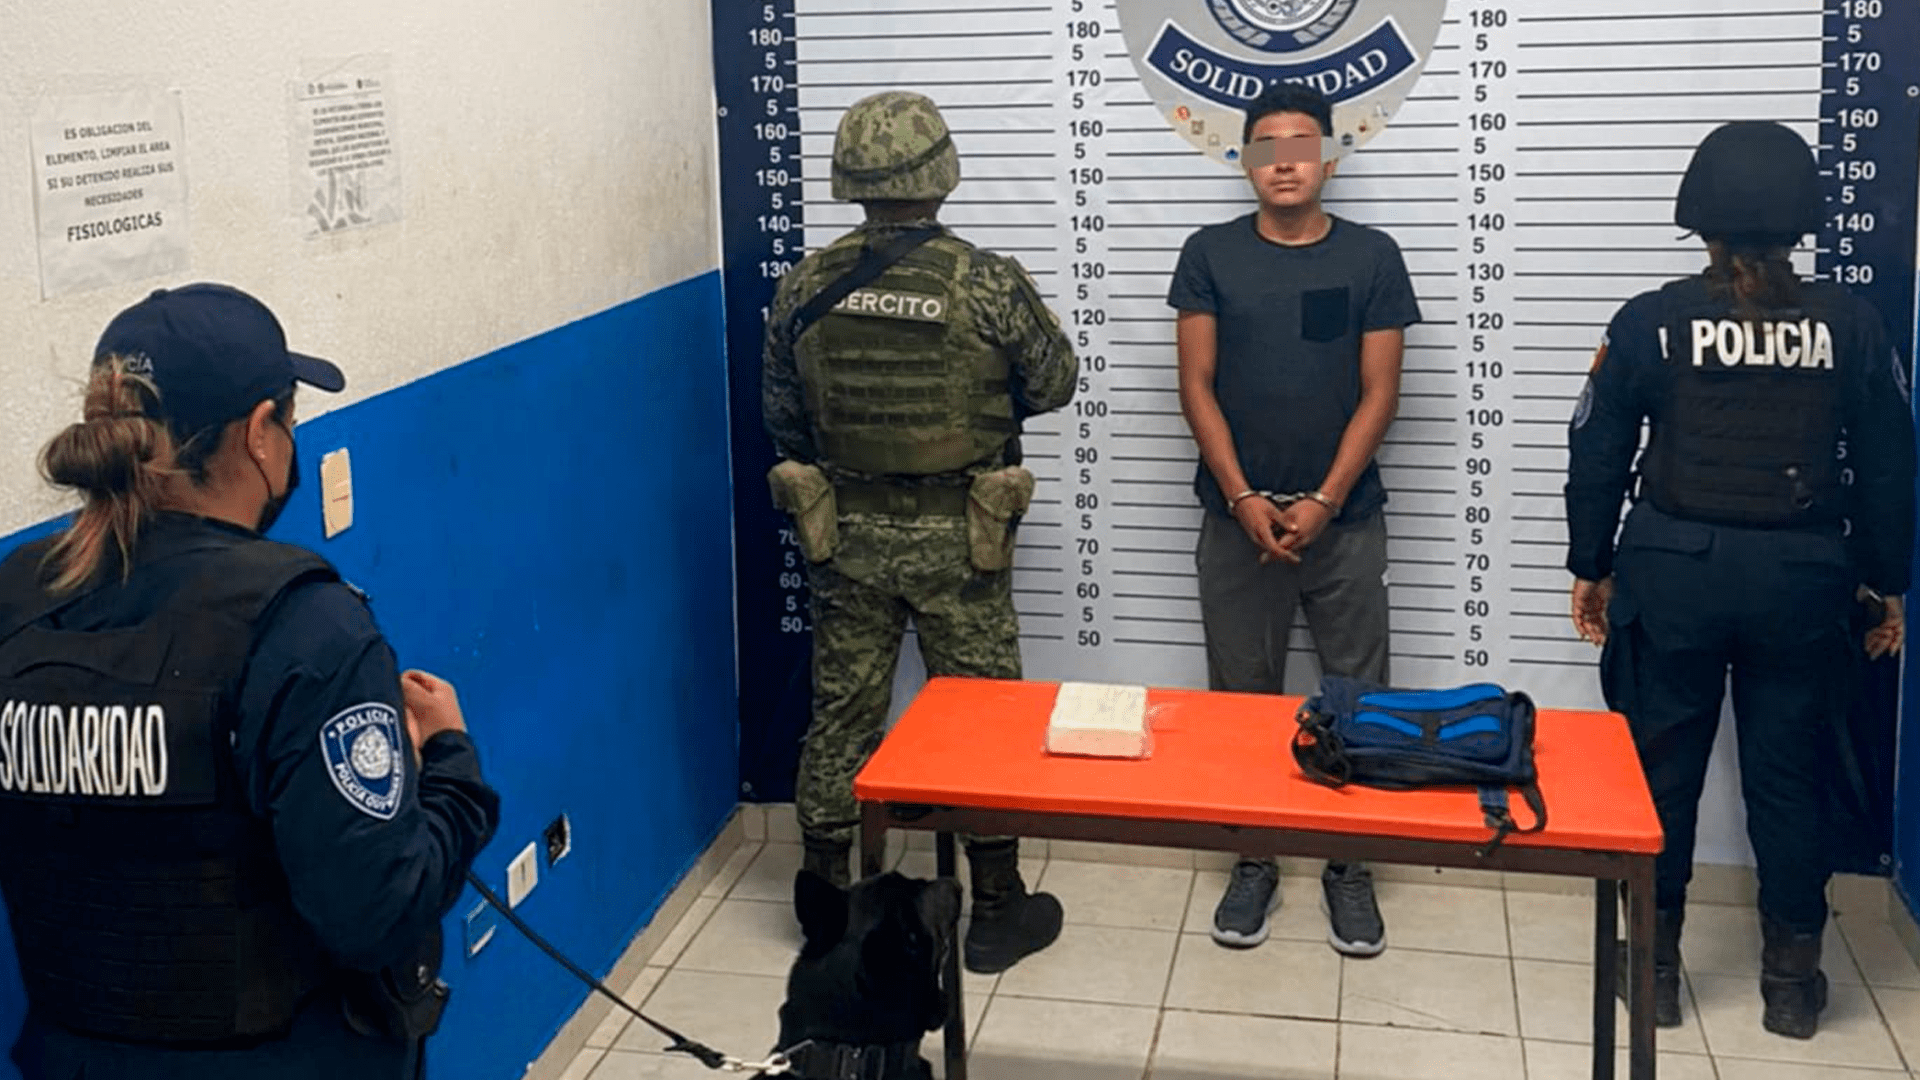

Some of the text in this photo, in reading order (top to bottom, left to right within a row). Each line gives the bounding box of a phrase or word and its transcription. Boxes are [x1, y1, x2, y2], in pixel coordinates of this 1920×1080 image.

[763, 4, 774, 22] 5
[1071, 0, 1083, 12] 5
[1841, 0, 1882, 18] 180
[1469, 8, 1507, 27] 180
[749, 28, 782, 45] 180
[1066, 20, 1100, 38] 180
[1846, 23, 1861, 43] 5
[1475, 33, 1488, 51] 5
[765, 51, 776, 69] 5
[1071, 43, 1083, 61] 5
[1839, 51, 1880, 71] 170
[1066, 69, 1100, 86] 170
[1468, 60, 1506, 78] 170
[751, 75, 783, 92] 170
[1845, 76, 1859, 95] 5
[1072, 92, 1084, 109] 5
[1474, 84, 1487, 102] 5
[766, 98, 778, 116] 5
[1468, 112, 1506, 131] 160
[1837, 108, 1878, 127] 160
[63, 120, 153, 140] ES OBLIGACION DEL
[754, 122, 787, 140] 160
[1068, 119, 1103, 137] 160
[100, 144, 137, 160] LIMPIAR
[138, 142, 149, 155] EL
[149, 141, 171, 153] AREA
[1074, 142, 1085, 159] 5
[1473, 136, 1486, 154] 5
[1842, 133, 1856, 151] 5
[769, 146, 781, 163] 5
[46, 161, 175, 191] SI SU DETENIDO REALIZA SUS
[755, 169, 788, 186] 150
[1069, 167, 1103, 185] 150
[1467, 163, 1505, 181] 150
[1835, 160, 1875, 179] 150
[84, 187, 144, 207] NECESIDADES
[771, 192, 783, 209] 5
[1075, 189, 1086, 206] 5
[1473, 186, 1485, 204] 5
[1841, 185, 1854, 204] 5
[67, 211, 163, 243] FISIOLOGICAS
[757, 215, 790, 232] 140
[1070, 214, 1104, 232] 140
[1467, 213, 1504, 231] 140
[1834, 213, 1874, 231] 140
[772, 238, 784, 255] 5
[1075, 236, 1087, 253] 5
[1472, 236, 1485, 254] 5
[1839, 237, 1853, 255] 5
[1071, 261, 1104, 279] 130
[1466, 262, 1504, 280] 130
[1832, 264, 1872, 283] 130
[1076, 283, 1088, 300] 5
[1472, 285, 1484, 303] 5
[1071, 308, 1105, 325] 120
[1466, 312, 1503, 330] 120
[1077, 330, 1089, 347] 5
[1472, 334, 1484, 352] 5
[1465, 360, 1502, 378] 110
[1078, 376, 1091, 393] 5
[1471, 383, 1484, 401] 5
[1073, 400, 1107, 417] 100
[1465, 408, 1503, 426] 100
[1079, 422, 1090, 439] 5
[1471, 431, 1483, 449] 5
[1074, 446, 1097, 463] 90
[1465, 457, 1491, 475] 90
[1079, 468, 1091, 484] 5
[1470, 480, 1482, 497] 5
[1074, 492, 1098, 509] 80
[1080, 513, 1092, 530] 5
[1464, 505, 1490, 523] 80
[1470, 528, 1482, 545] 5
[1075, 537, 1098, 555] 70
[784, 550, 795, 568] 5
[1081, 558, 1093, 575] 5
[1464, 553, 1489, 571] 70
[779, 571, 801, 588] 60
[1470, 575, 1482, 592] 5
[1076, 582, 1099, 599] 60
[785, 595, 797, 611] 5
[1463, 599, 1489, 617] 60
[1082, 606, 1093, 622] 5
[780, 616, 802, 633] 50
[1469, 624, 1482, 641] 5
[1077, 629, 1100, 646] 50
[1464, 649, 1488, 666] 50
[0, 699, 168, 796] SOLIDARIDAD
